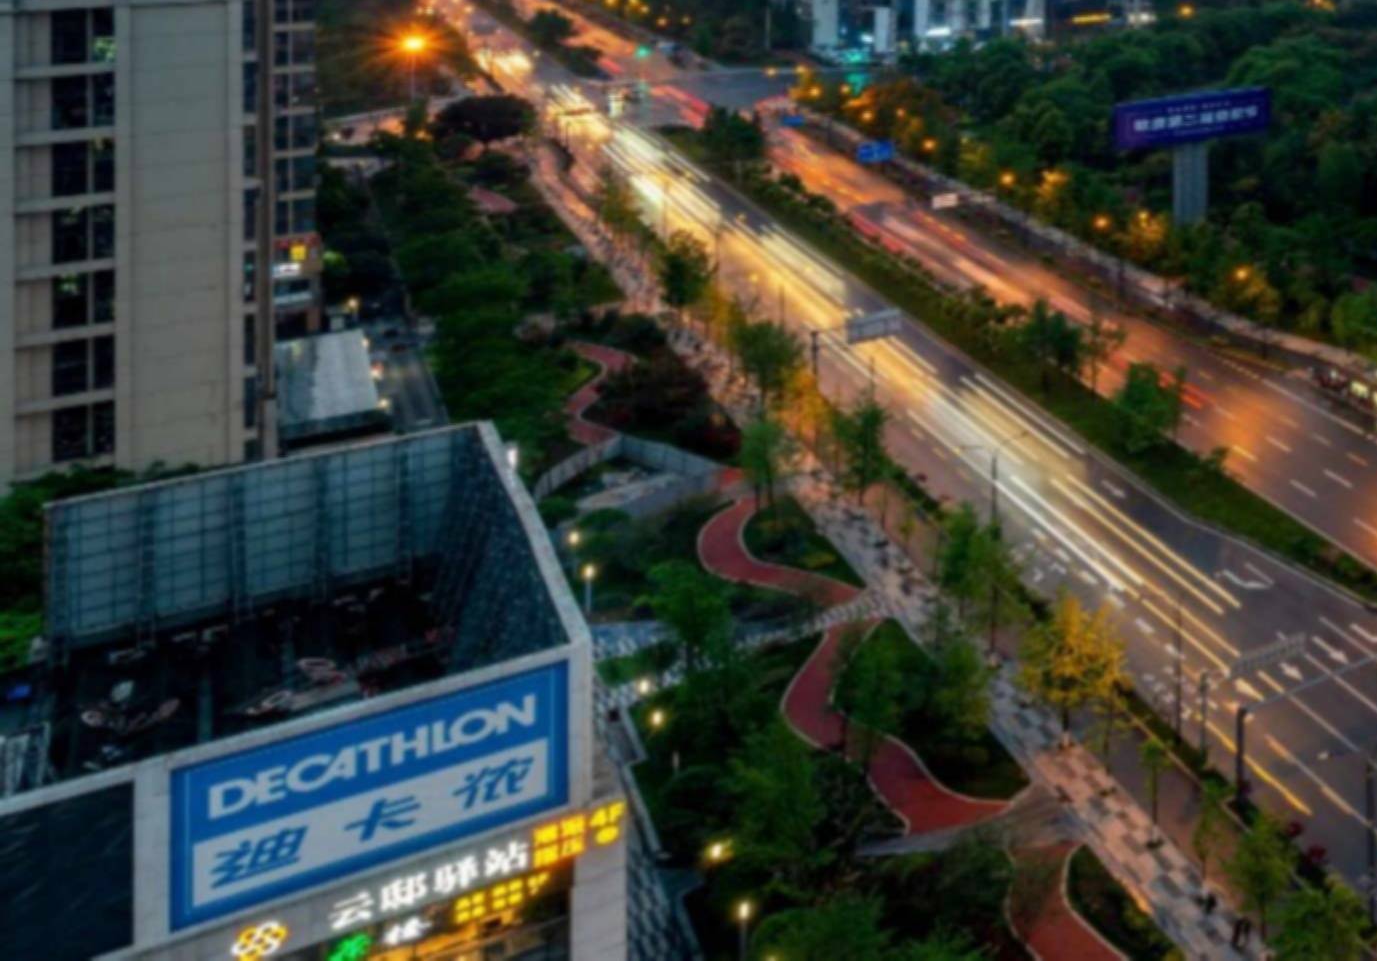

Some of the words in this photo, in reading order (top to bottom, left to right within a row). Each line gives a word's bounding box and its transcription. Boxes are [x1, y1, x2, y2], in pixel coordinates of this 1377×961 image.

[208, 694, 536, 820] DECATHLON
[210, 756, 534, 889] 迪卡侬
[329, 840, 530, 931] 云邸驿站
